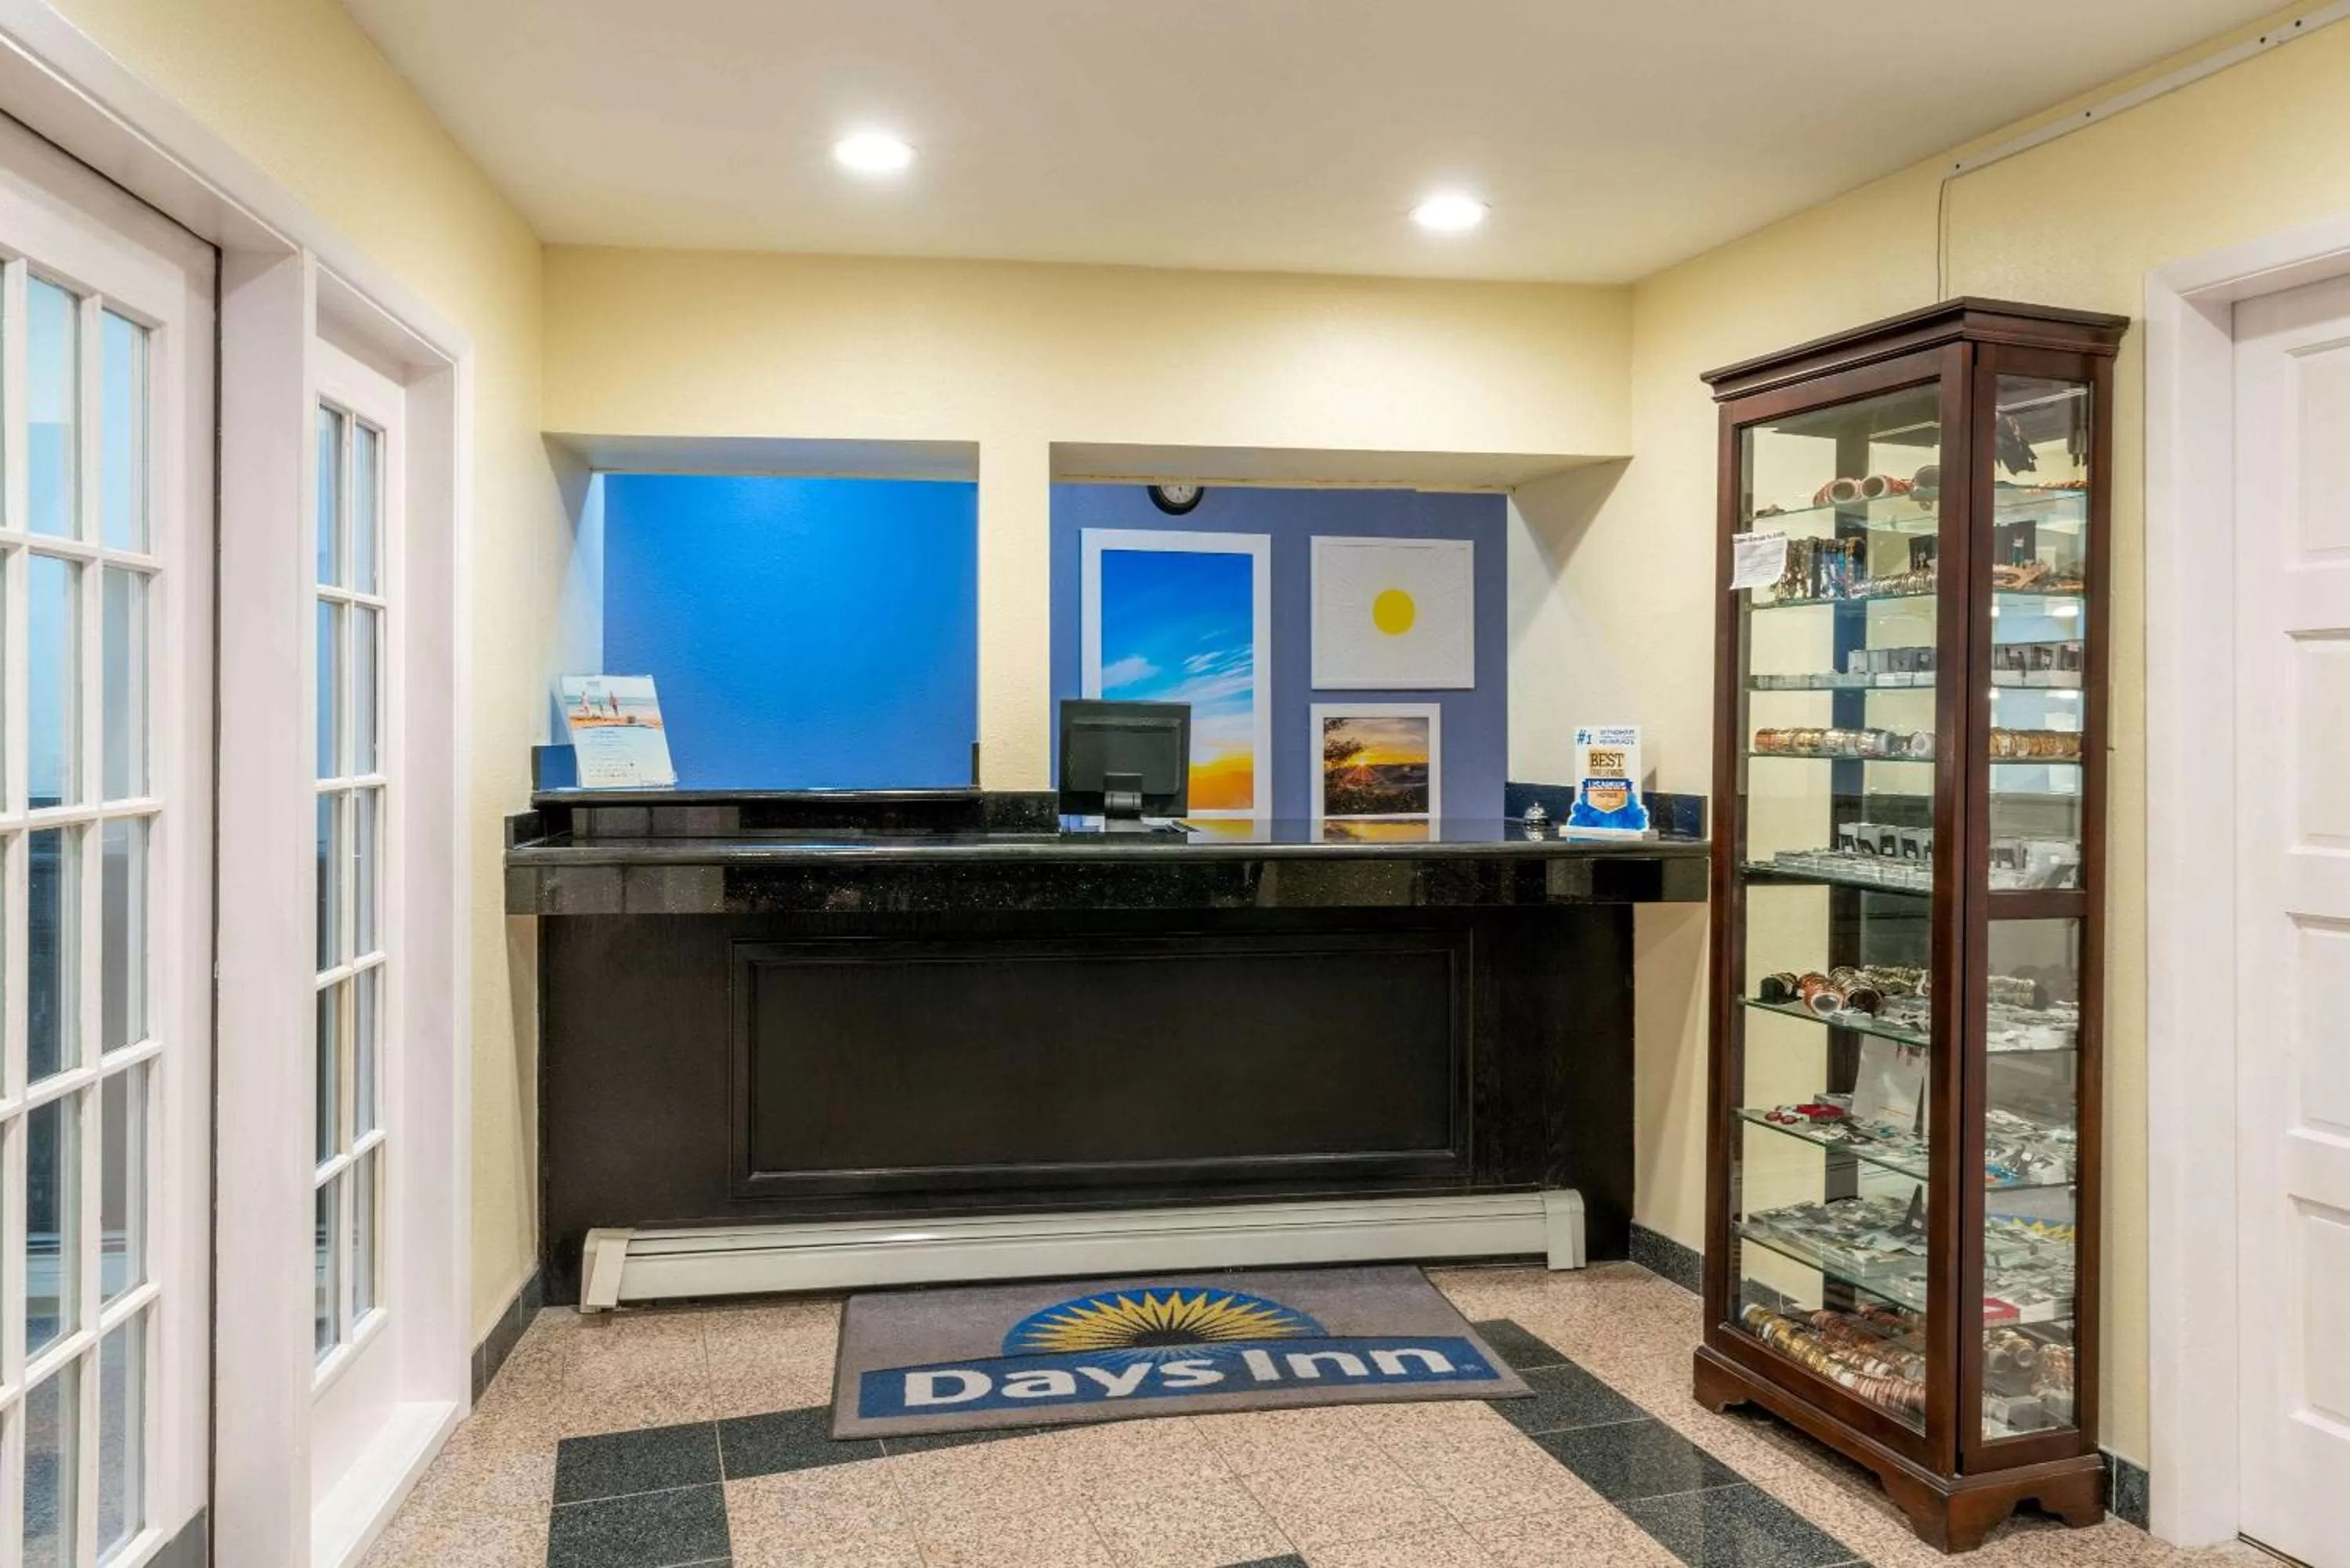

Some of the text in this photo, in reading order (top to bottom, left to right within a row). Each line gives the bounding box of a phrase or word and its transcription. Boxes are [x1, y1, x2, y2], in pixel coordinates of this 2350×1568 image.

[1577, 729, 1593, 746] #1
[1590, 753, 1625, 768] BEST
[904, 1348, 1458, 1407] Days Inn
